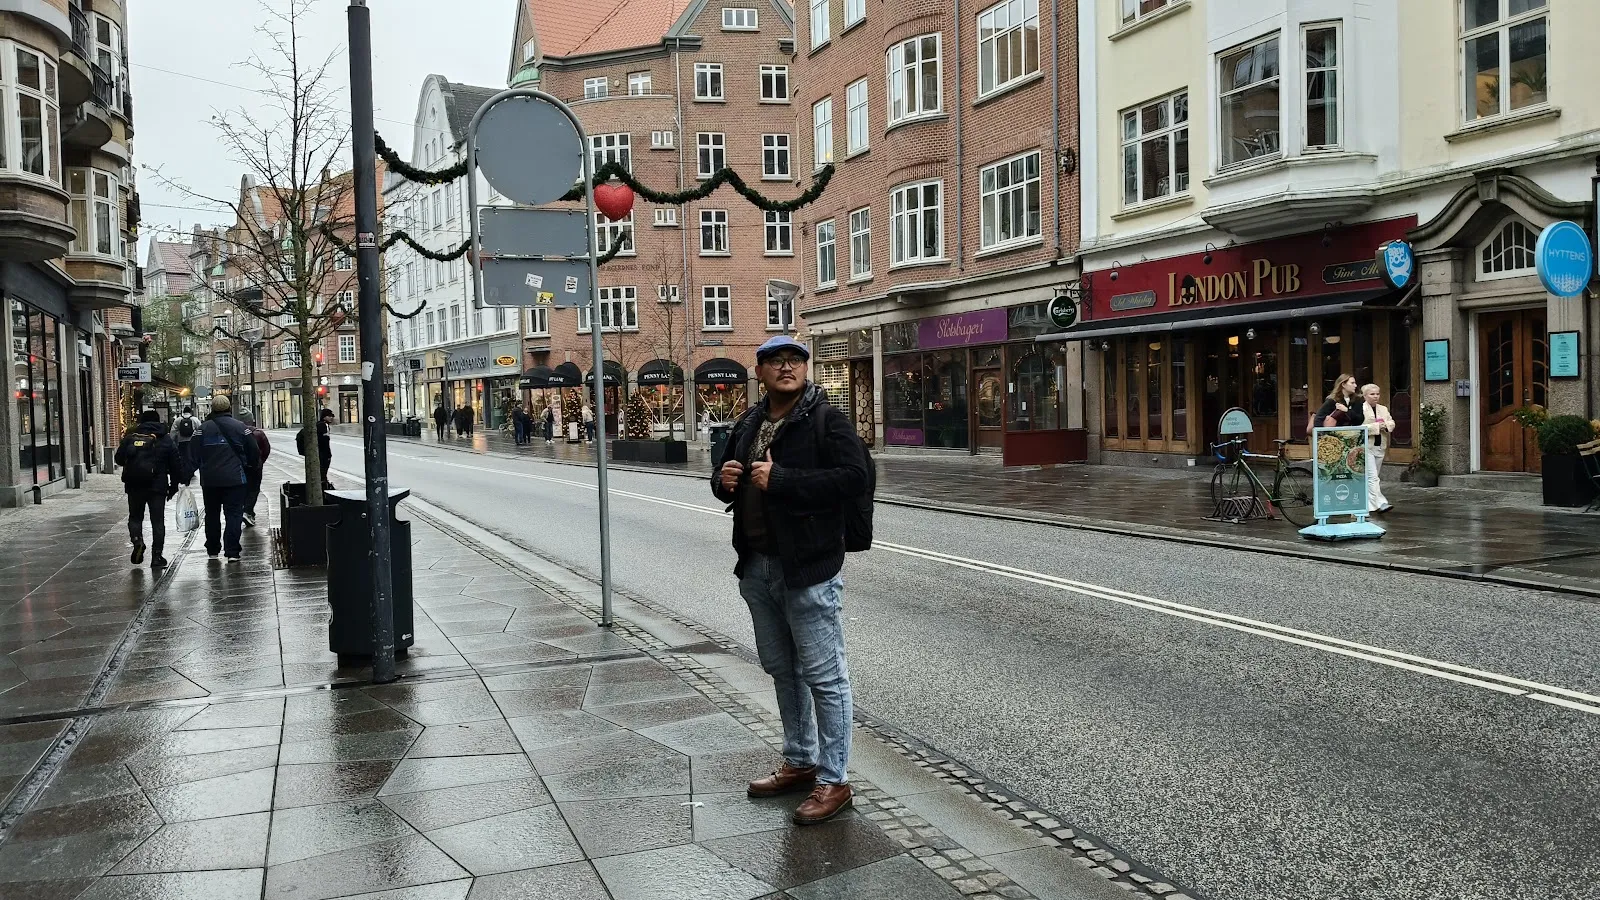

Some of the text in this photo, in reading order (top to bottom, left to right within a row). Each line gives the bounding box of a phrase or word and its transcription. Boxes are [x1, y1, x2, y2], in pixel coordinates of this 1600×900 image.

[1388, 246, 1405, 256] BREW
[1548, 249, 1586, 262] HYTTENS
[1332, 266, 1357, 280] Fine
[1168, 258, 1301, 307] LONDON PUB
[1052, 305, 1075, 317] Carlsberg
[936, 318, 985, 343] Slotsbageri
